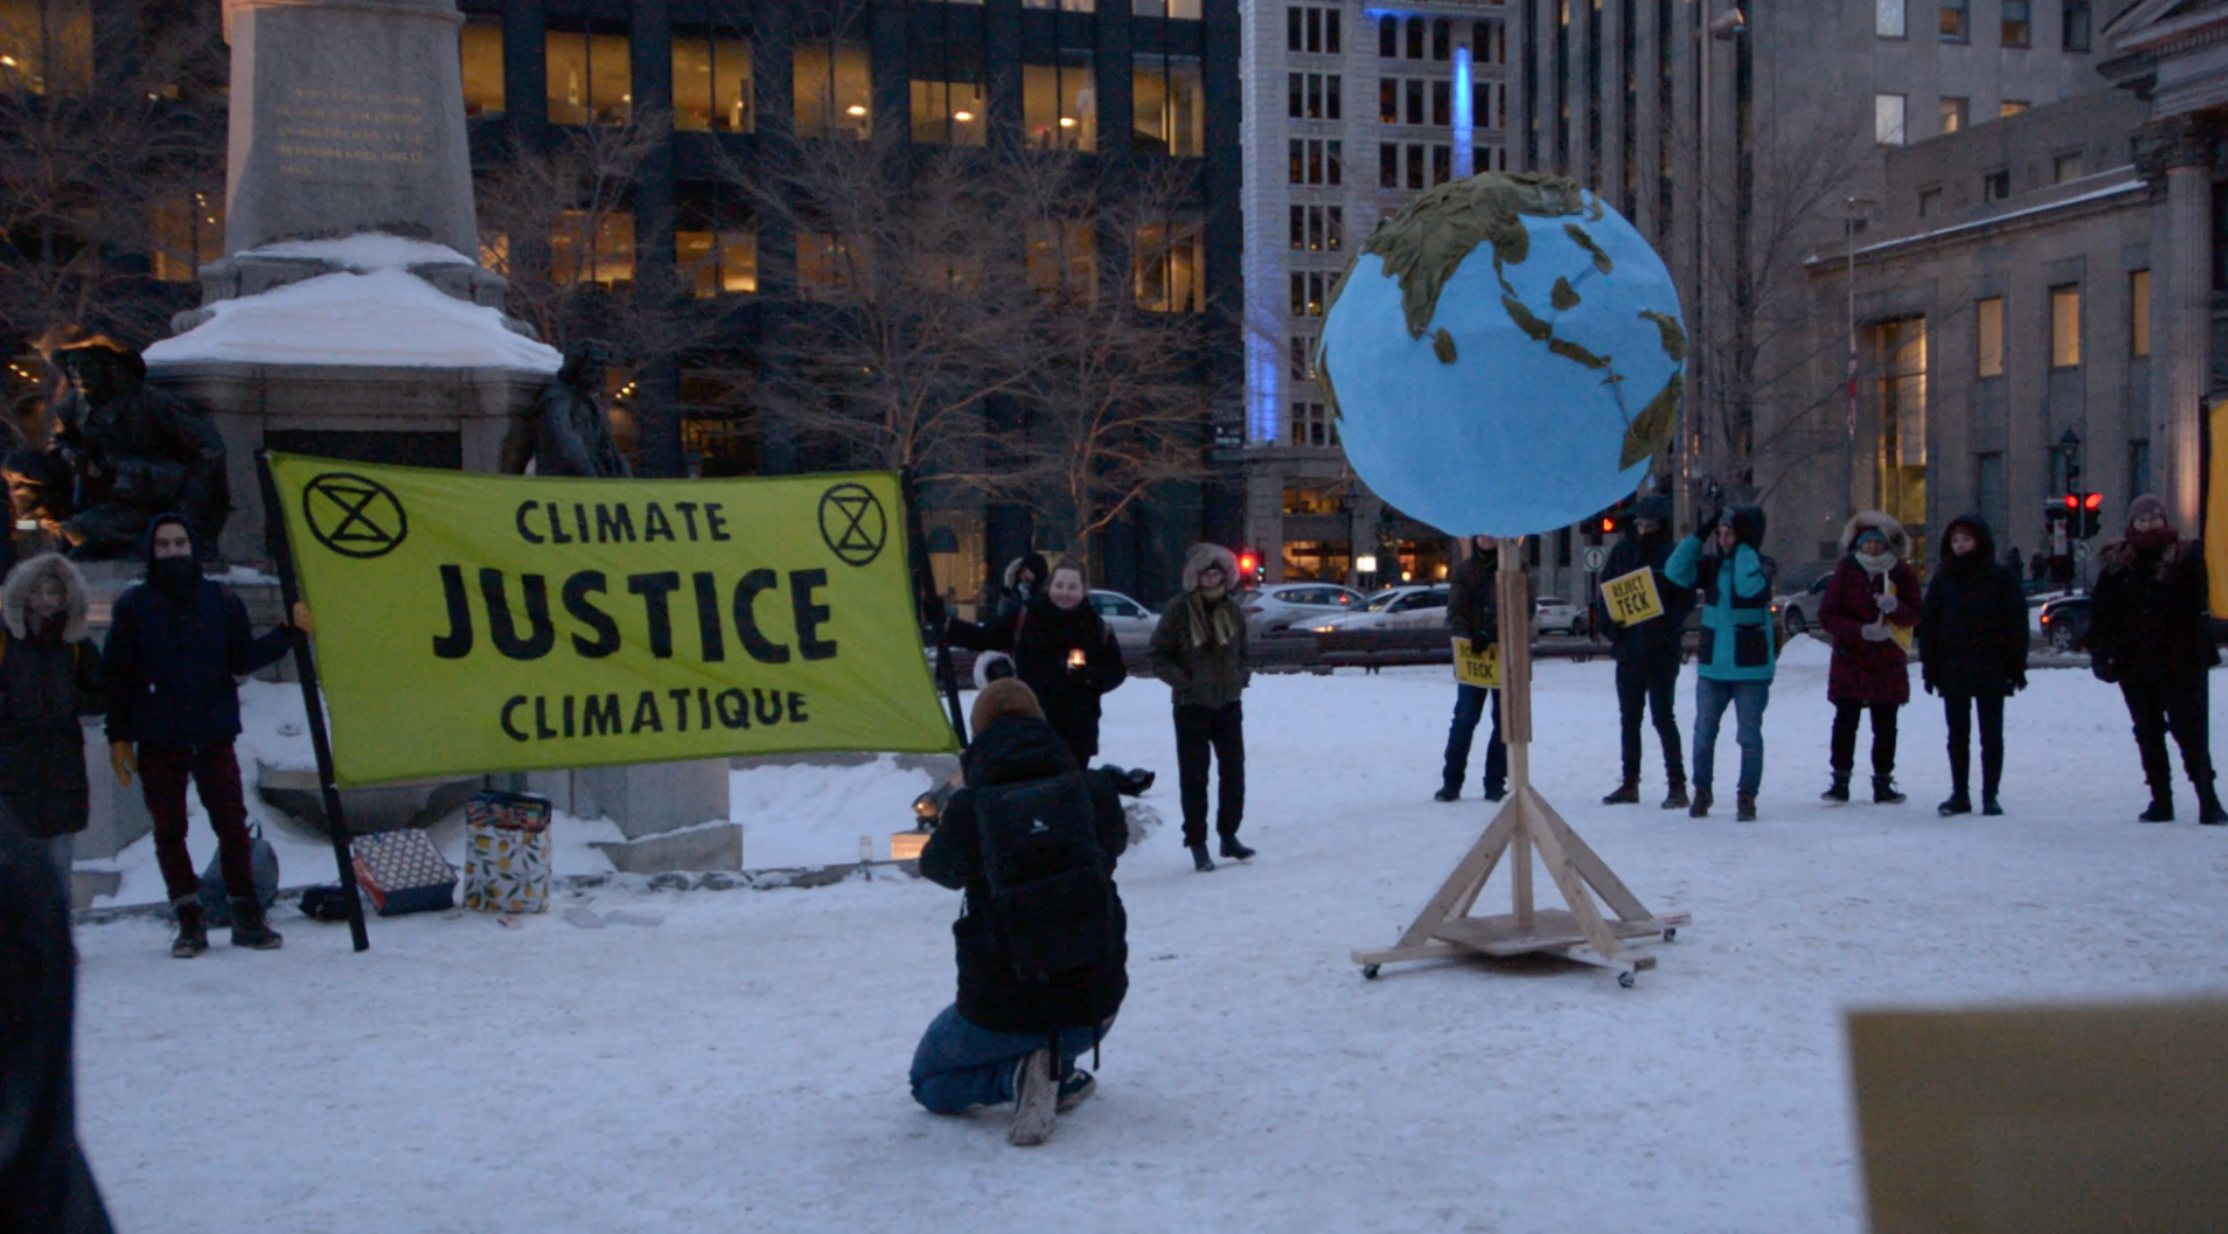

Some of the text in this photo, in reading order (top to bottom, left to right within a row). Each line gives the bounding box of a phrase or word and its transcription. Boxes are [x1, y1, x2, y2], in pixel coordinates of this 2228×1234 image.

[516, 500, 731, 545] CLIMATE
[1611, 574, 1645, 598] REJECT
[1616, 590, 1650, 618] TECK
[432, 564, 839, 664] JUSTICE
[1466, 660, 1494, 679] TECK
[501, 688, 809, 742] CLIMATIQUE
